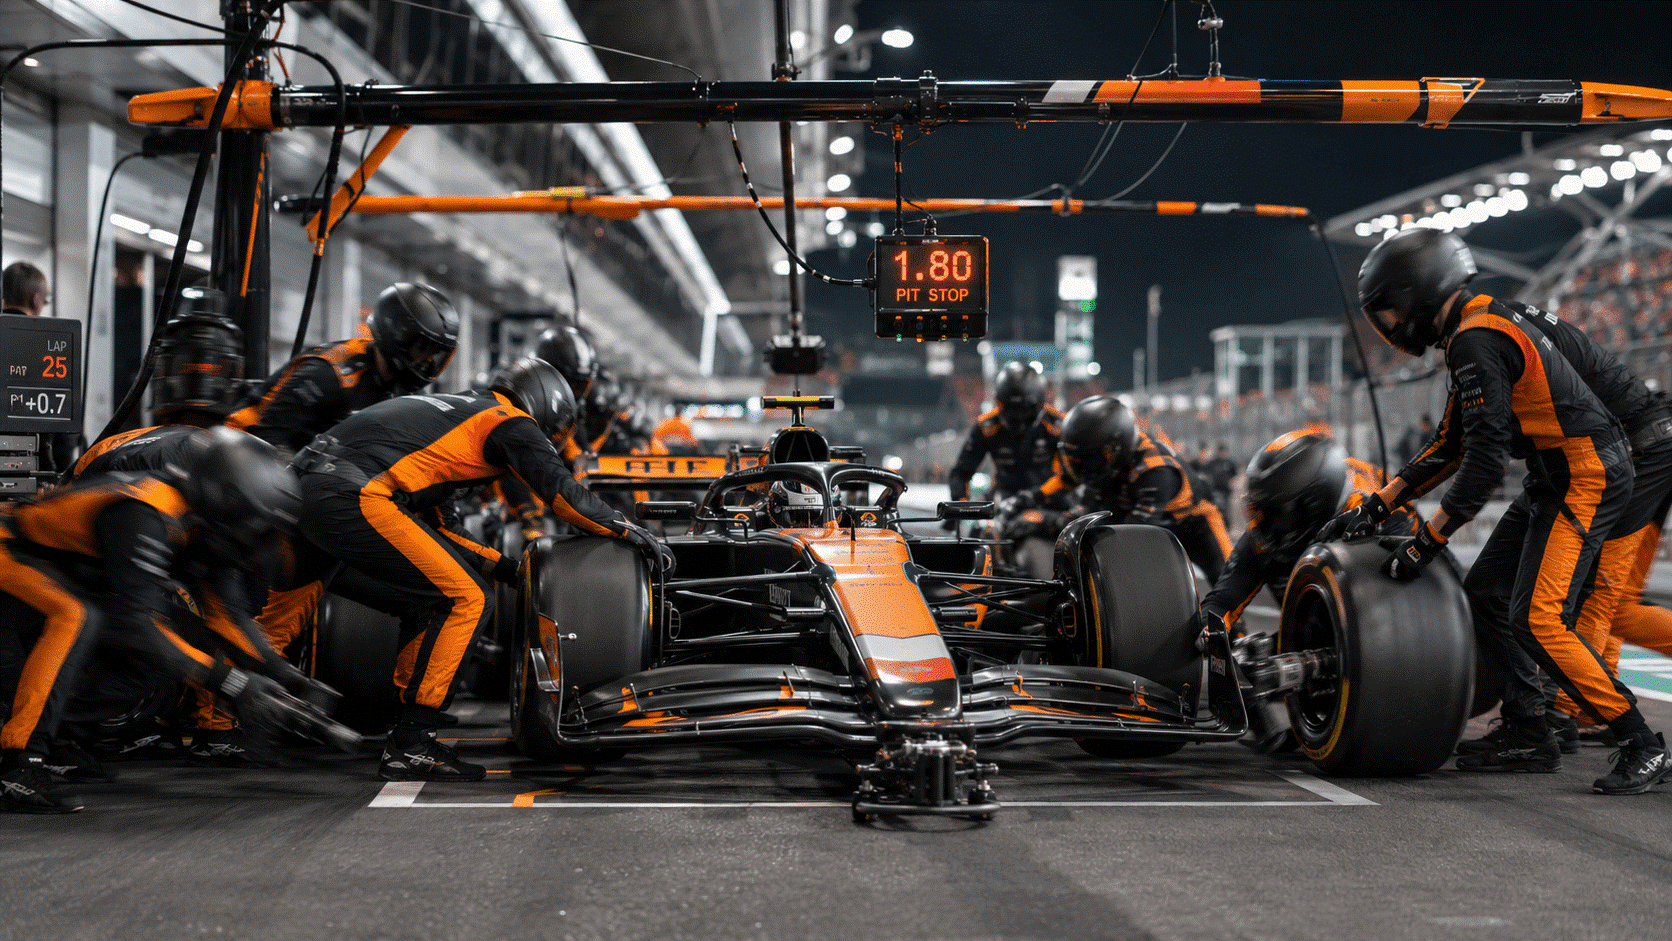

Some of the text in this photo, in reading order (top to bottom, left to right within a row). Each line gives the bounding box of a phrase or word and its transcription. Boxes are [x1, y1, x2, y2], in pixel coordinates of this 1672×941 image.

[894, 250, 972, 282] 1.80
[896, 288, 969, 302] PIT STOP
[47, 339, 67, 352] LAP
[42, 355, 67, 378] 25
[25, 392, 66, 414] +0.7
